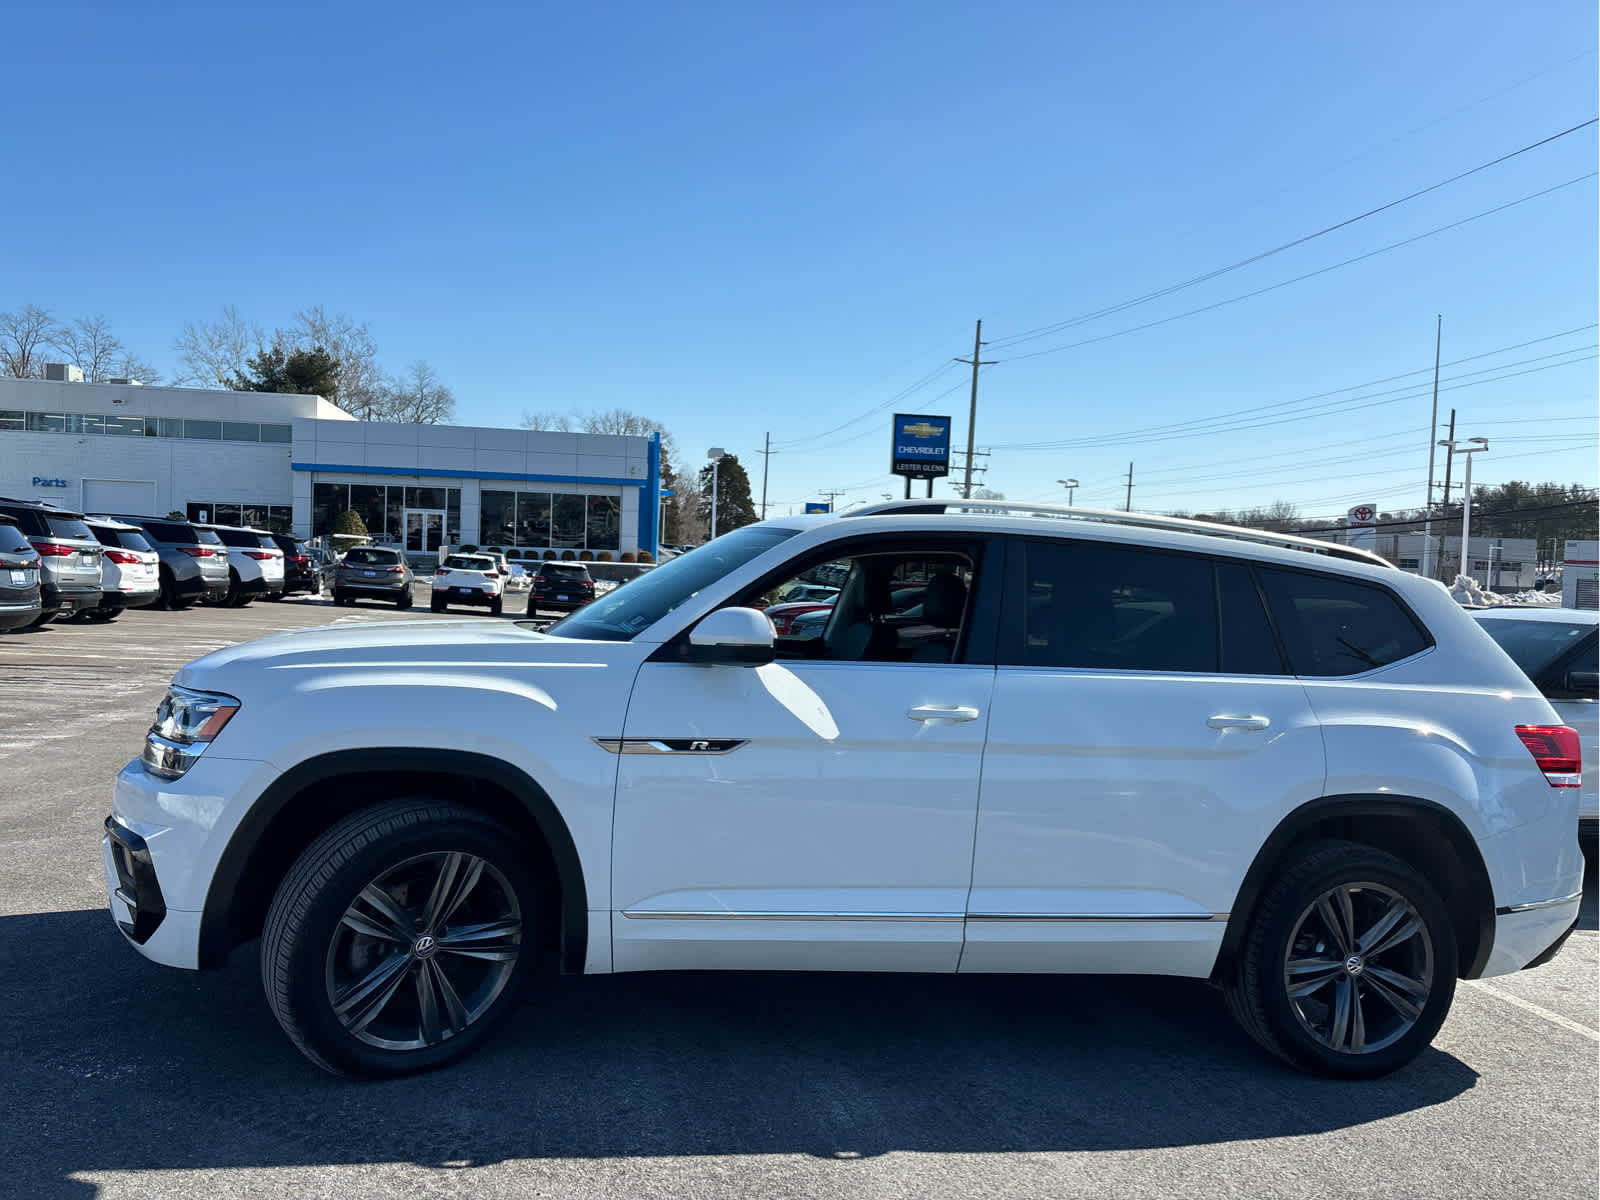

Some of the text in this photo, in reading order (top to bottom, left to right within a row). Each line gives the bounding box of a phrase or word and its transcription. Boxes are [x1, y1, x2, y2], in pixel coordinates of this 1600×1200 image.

[898, 446, 945, 455] CHEVROLET
[896, 463, 945, 472] LESTER GLENN
[32, 476, 67, 488] Parts
